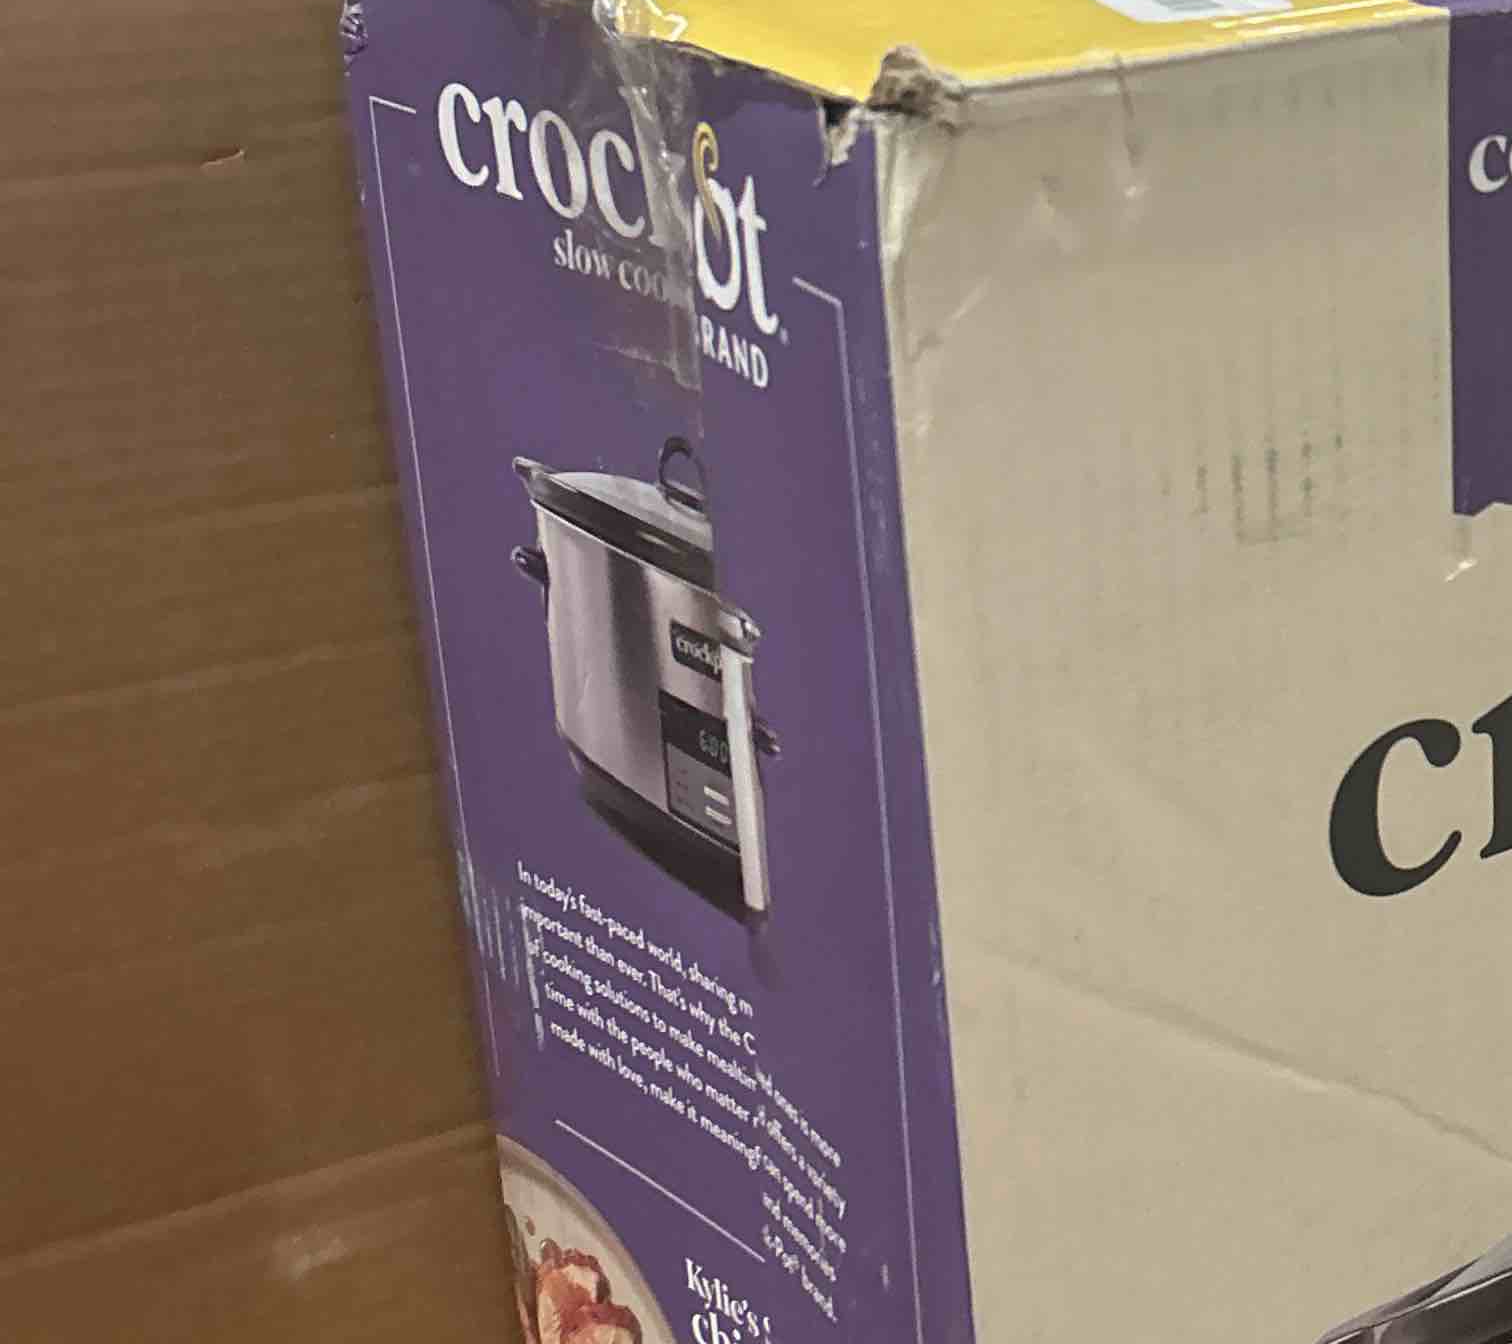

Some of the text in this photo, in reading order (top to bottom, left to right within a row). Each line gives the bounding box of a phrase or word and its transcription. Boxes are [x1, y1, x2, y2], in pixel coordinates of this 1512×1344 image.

[553, 228, 613, 281] slow
[697, 314, 769, 389] RAND
[518, 859, 532, 885] In
[533, 873, 577, 912] today's
[688, 961, 738, 1015] sharing
[542, 951, 593, 997] cooking
[594, 978, 651, 1023] solutions
[652, 1011, 667, 1034] to
[668, 1026, 704, 1057] make
[544, 980, 574, 1012] time
[576, 1000, 604, 1030] with
[606, 1016, 628, 1045] the
[630, 1035, 673, 1072] people
[675, 1062, 704, 1091] who
[584, 935, 614, 967] than
[689, 1000, 715, 1036] why
[718, 1016, 741, 1047] the
[549, 1020, 586, 1052] made
[587, 1042, 616, 1071] with
[685, 1257, 760, 1337] Kylie's
